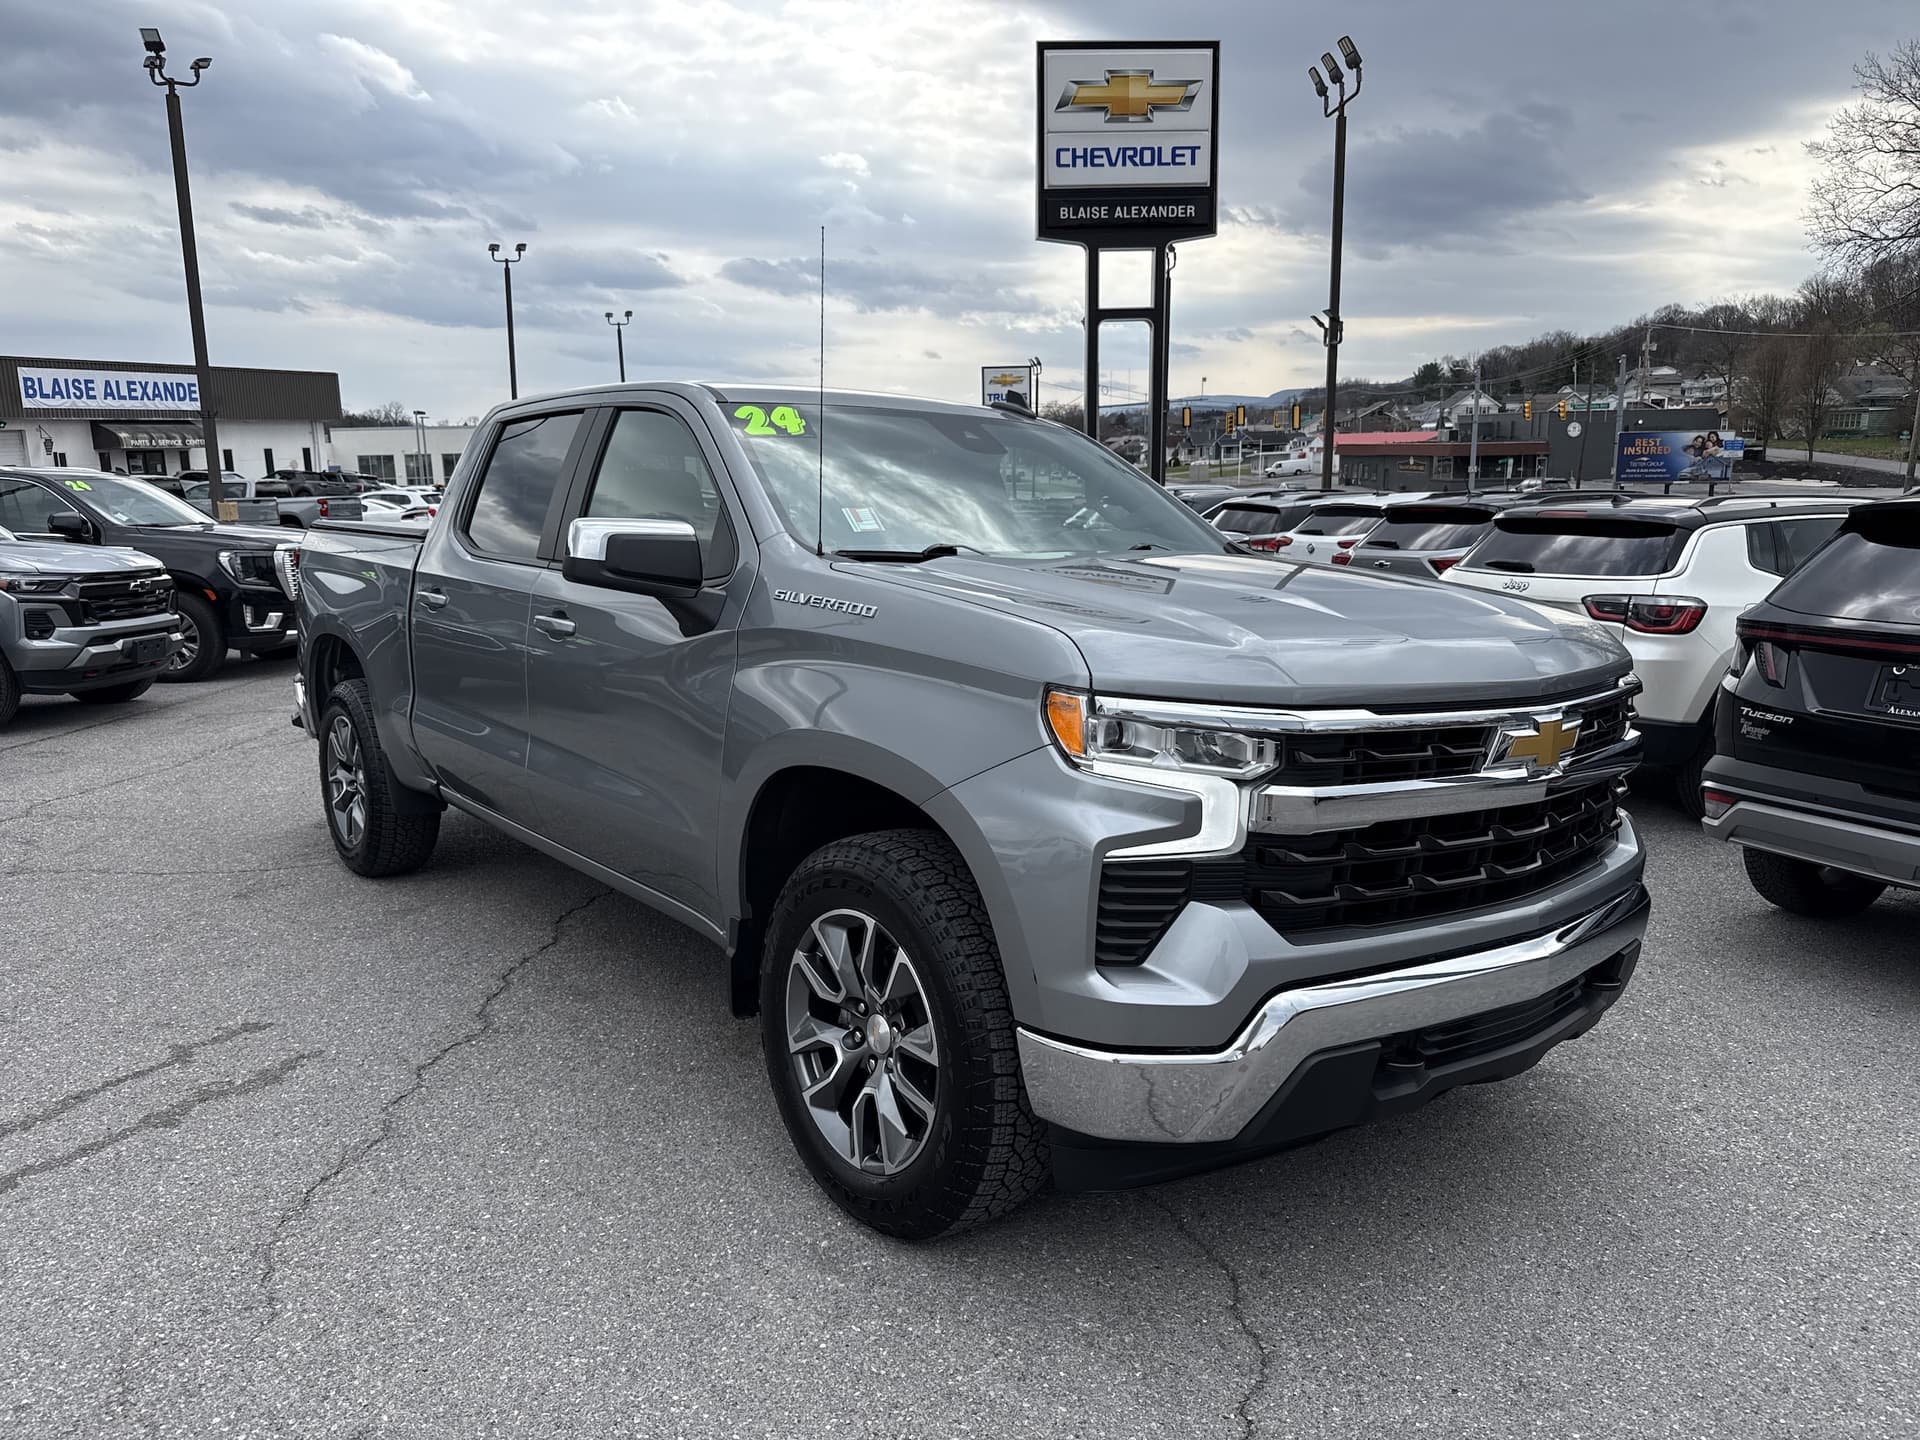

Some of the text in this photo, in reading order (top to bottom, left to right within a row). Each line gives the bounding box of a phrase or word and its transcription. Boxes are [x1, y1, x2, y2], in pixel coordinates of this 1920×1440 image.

[1055, 146, 1201, 168] CHEVROLET
[1059, 205, 1196, 219] BLAISE ALEXANDER
[22, 376, 199, 403] BLAISE ALEXANDE
[987, 392, 1027, 402] TRUS
[734, 405, 806, 436] 24
[185, 438, 206, 446] CENTE
[1634, 438, 1662, 447] REST
[1623, 446, 1672, 455] INSURED
[1502, 578, 1530, 592] Jeep
[773, 589, 878, 618] SILVERADO
